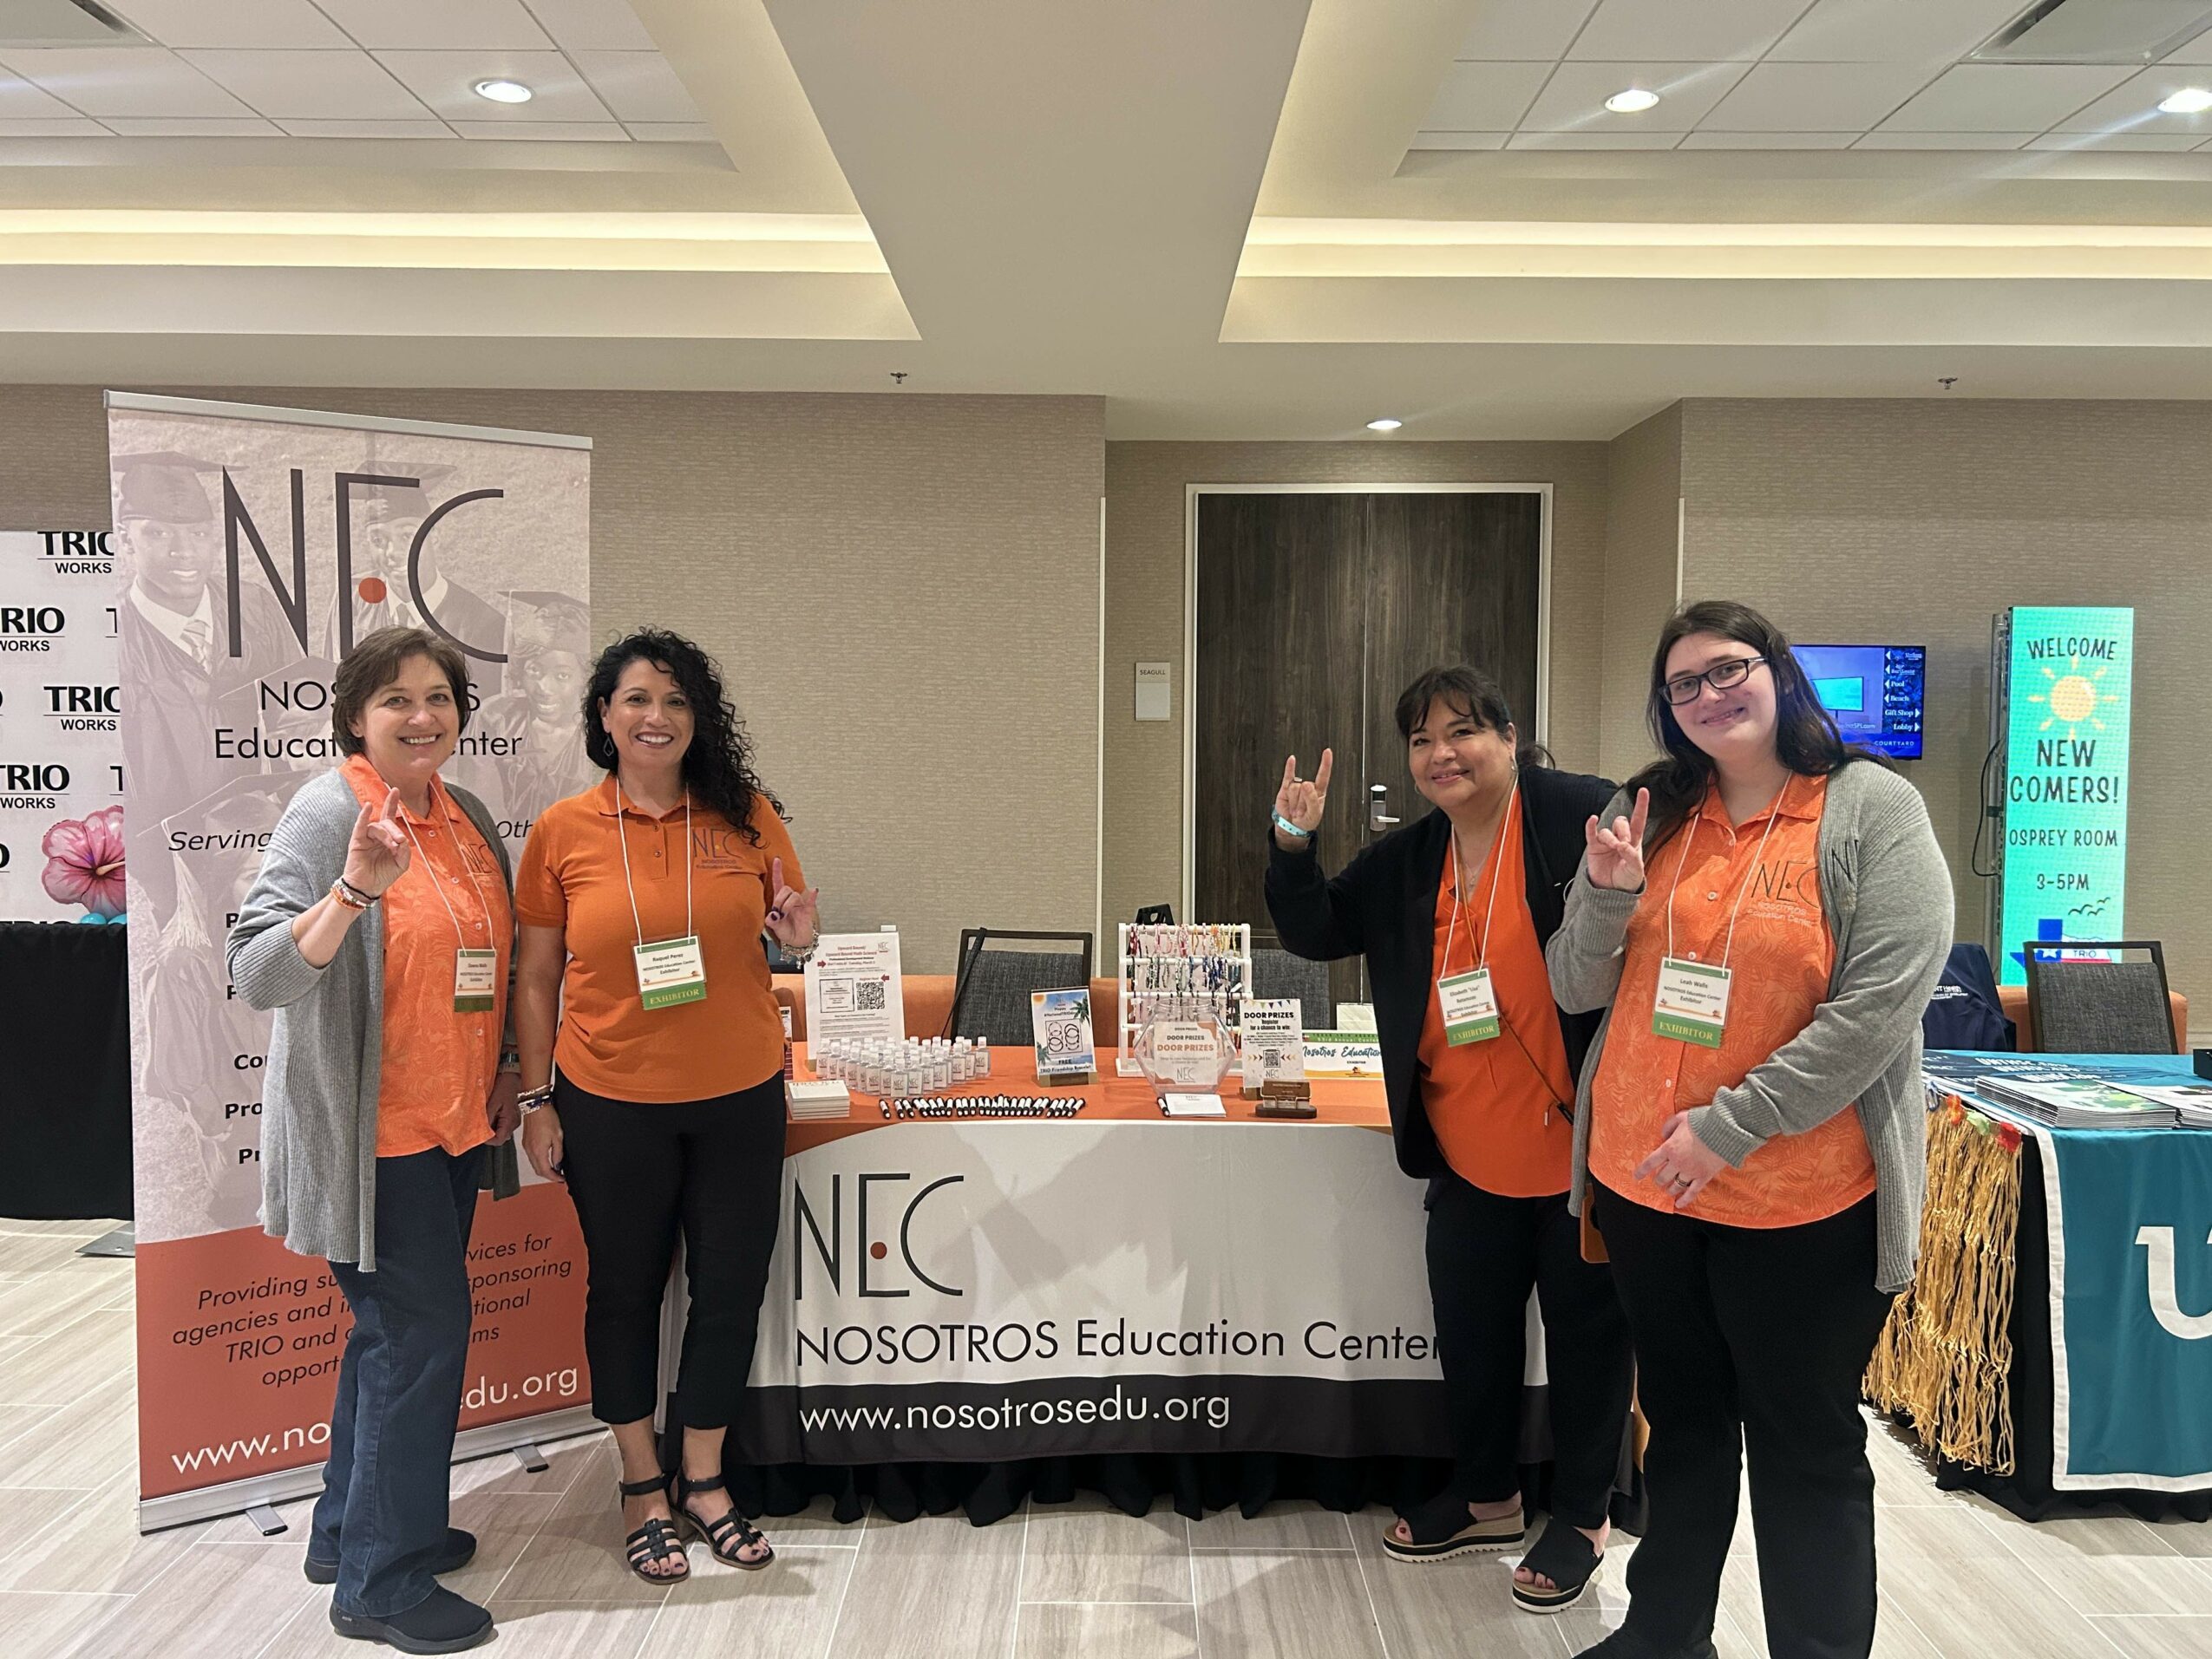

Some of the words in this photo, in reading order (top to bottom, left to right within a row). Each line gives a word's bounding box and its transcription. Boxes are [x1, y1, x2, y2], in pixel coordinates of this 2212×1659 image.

[56, 562, 112, 574] WORKS
[223, 465, 507, 663] NEC
[0, 607, 65, 634] RIO
[2027, 637, 2117, 660] WELCOME
[61, 719, 116, 731] WORKS
[1894, 723, 1913, 732] Lobby
[2037, 739, 2096, 767] NEW
[2010, 775, 2119, 804] COMERS!
[0, 798, 56, 809] WORKS
[2009, 829, 2067, 846] OSPREY
[2073, 829, 2118, 847] ROOM
[2037, 873, 2090, 892] 3-5PM
[2074, 950, 2097, 958] TRIO
[650, 989, 700, 1005] EXHIBITOR
[1453, 1025, 1495, 1041] EXHIBITOR
[1659, 1022, 1713, 1041] EXHIBITOR
[1176, 1068, 1194, 1081] NEC
[795, 1172, 965, 1301] NEC
[199, 1277, 307, 1310] Providing
[468, 1243, 517, 1262] vices
[524, 1233, 553, 1253] for
[173, 1310, 278, 1346] agencies
[287, 1297, 332, 1323] and
[468, 1259, 572, 1294] ponsoring
[226, 1335, 285, 1363] TRIO
[292, 1323, 337, 1350] and
[473, 1288, 531, 1316] tional
[797, 1320, 1058, 1367] NOSOTROS
[1077, 1316, 1284, 1357] Education
[262, 1355, 340, 1388] opport
[800, 1384, 1231, 1434] www.nosotrosedu.org
